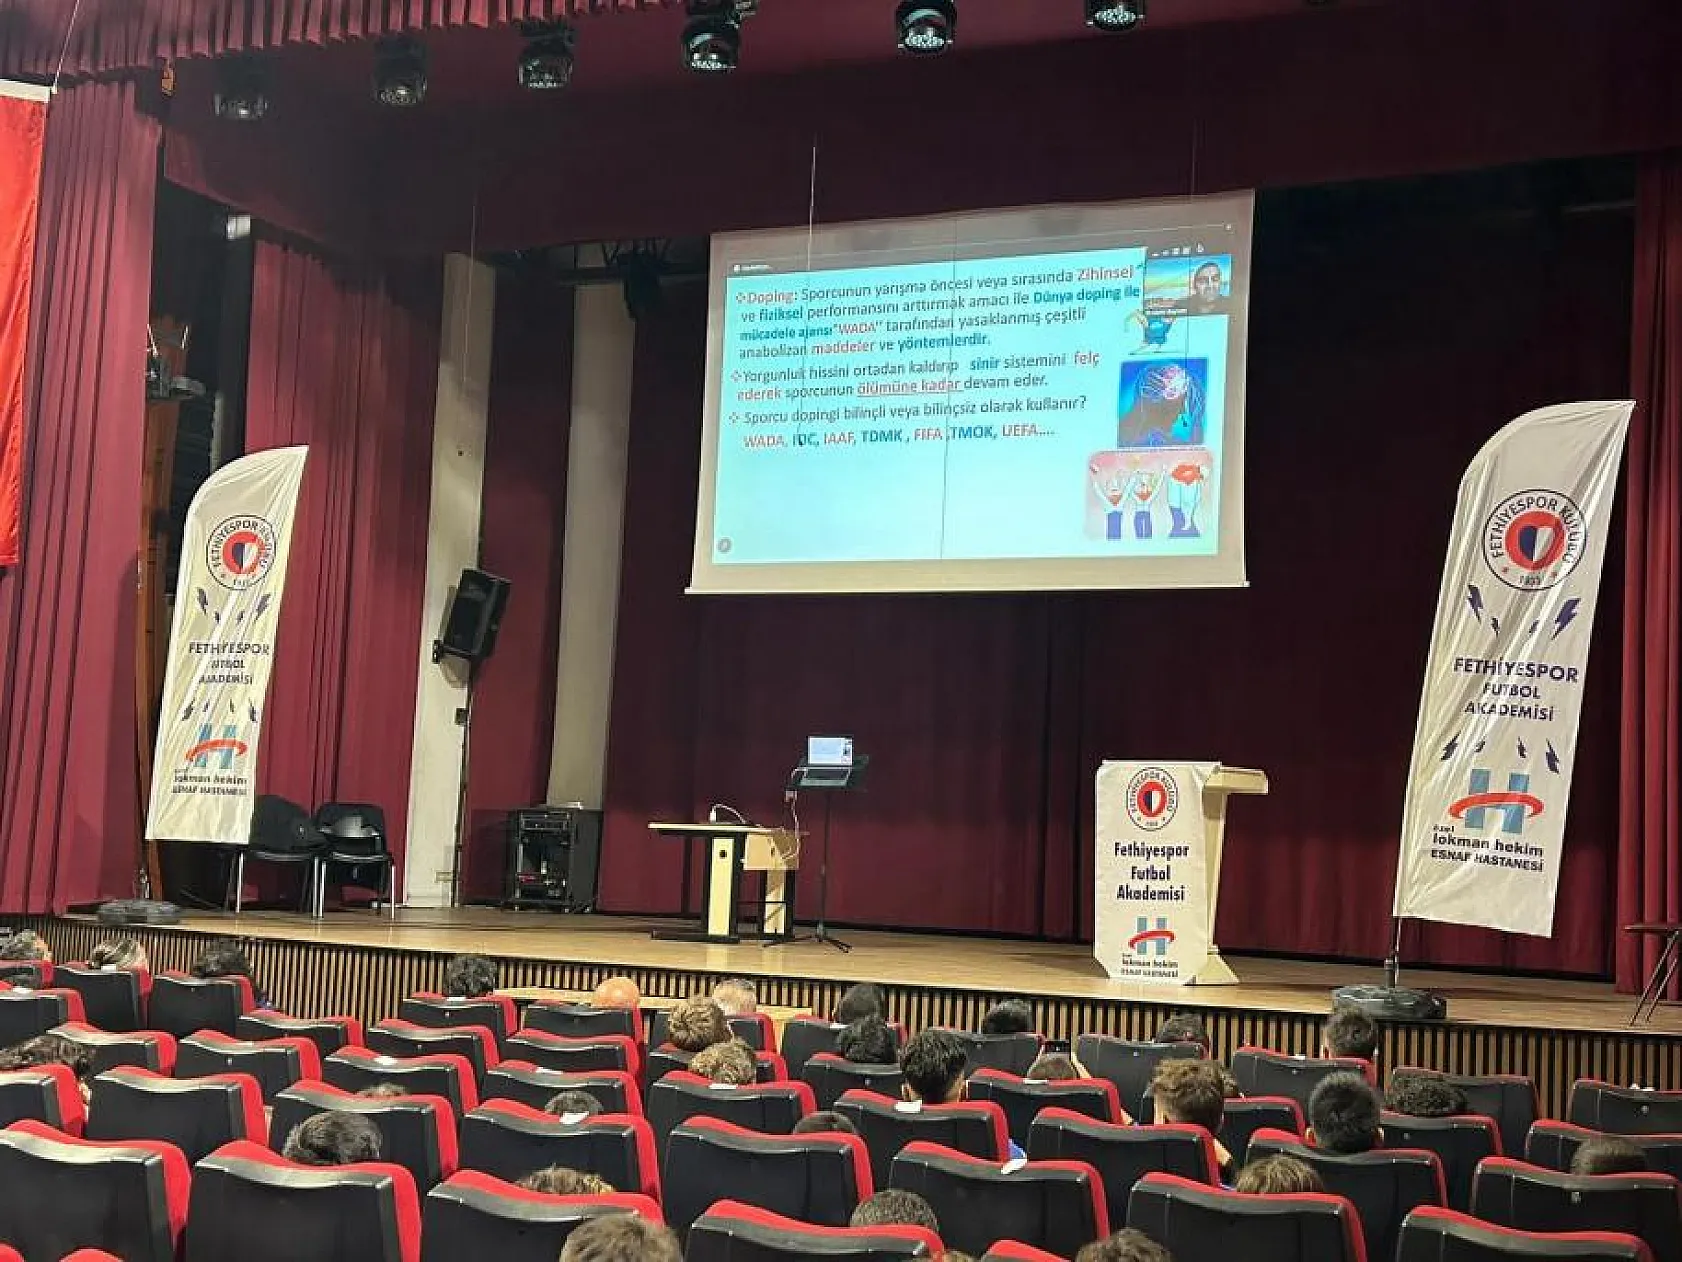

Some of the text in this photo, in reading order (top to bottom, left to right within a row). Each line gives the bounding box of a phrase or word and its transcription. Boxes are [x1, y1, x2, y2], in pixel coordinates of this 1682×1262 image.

[802, 285, 871, 302] Sporcunun
[875, 281, 926, 298] yarışma
[930, 275, 973, 291] öncesi
[977, 276, 1007, 290] veya
[1011, 269, 1074, 286] sırasında
[1078, 265, 1134, 281] Zihinsel
[741, 285, 1140, 322] ve fiziksel performansını arttırmak amacı ile Dünya doping ile
[739, 327, 796, 341] mücadele
[886, 313, 954, 331] tarafından
[958, 311, 1041, 330] yasaklanmış
[1045, 307, 1087, 325] çeşitli
[739, 342, 806, 359] anabolizan
[811, 339, 874, 355] maddeler
[879, 339, 894, 351] ve
[743, 367, 805, 384] Yorgunluk
[809, 365, 850, 380] hissini
[853, 362, 905, 378] ortadan
[969, 357, 1002, 371] sinir
[1003, 353, 1067, 369] sistemini
[1074, 351, 1101, 368] felç
[737, 387, 782, 401] ederek
[785, 386, 853, 402] sporcunun
[857, 380, 917, 396] ölümüne
[921, 377, 964, 393] kadar
[964, 376, 1010, 390] devam
[744, 395, 1087, 426] Sporcu dopingi bilinçli veya bilinçsiz olarak kullanır?
[189, 641, 270, 655] FETHYESPOR
[207, 659, 246, 669] UTBOL
[1482, 682, 1541, 699] FUTBOL
[1114, 841, 1190, 862] Fethiyespor
[1431, 849, 1473, 862] ESNAF
[1433, 832, 1543, 858] lokman hekim
[1131, 865, 1171, 881] Futbol
[1116, 885, 1185, 901] Akademisi
